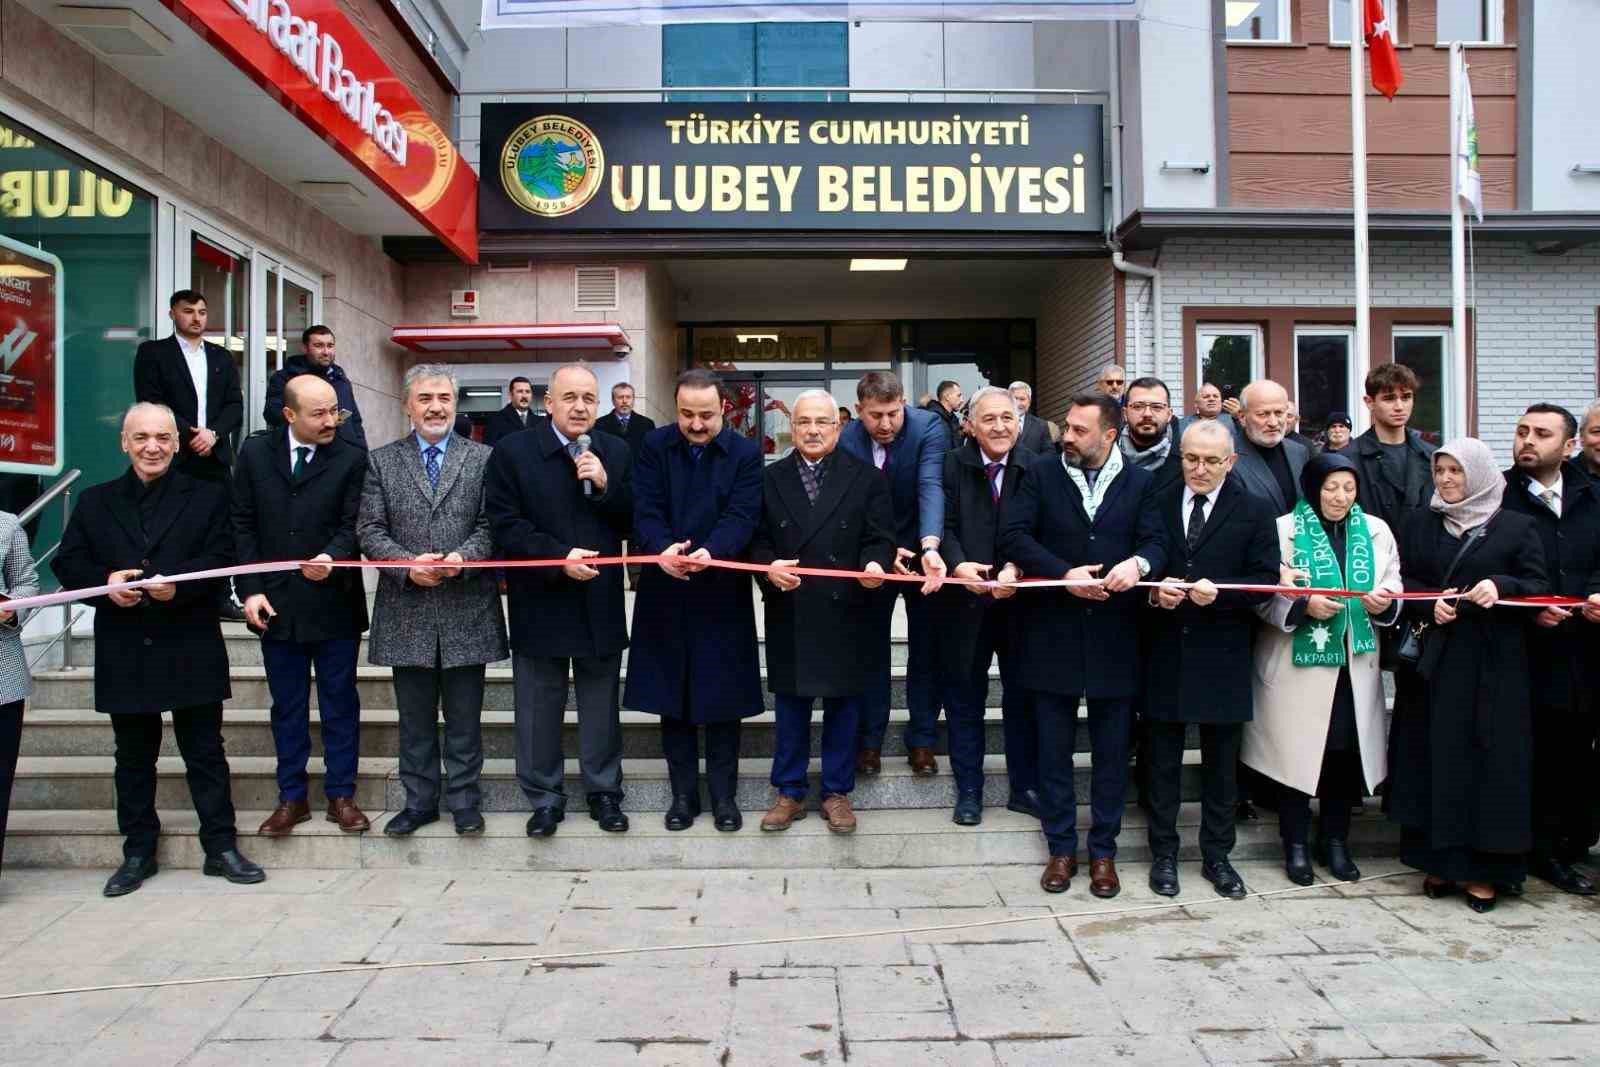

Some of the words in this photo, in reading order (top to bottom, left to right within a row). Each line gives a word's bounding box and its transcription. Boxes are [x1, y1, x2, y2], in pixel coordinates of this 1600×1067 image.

[320, 32, 408, 167] Bankası
[506, 125, 538, 169] ULUBEY
[665, 113, 800, 144] TÜRKİYE
[809, 114, 1030, 145] CUMHURİYETİ
[611, 165, 802, 212] ULUBEY
[818, 153, 1085, 214] BELEDİYESİ
[1352, 534, 1370, 584] ORDU
